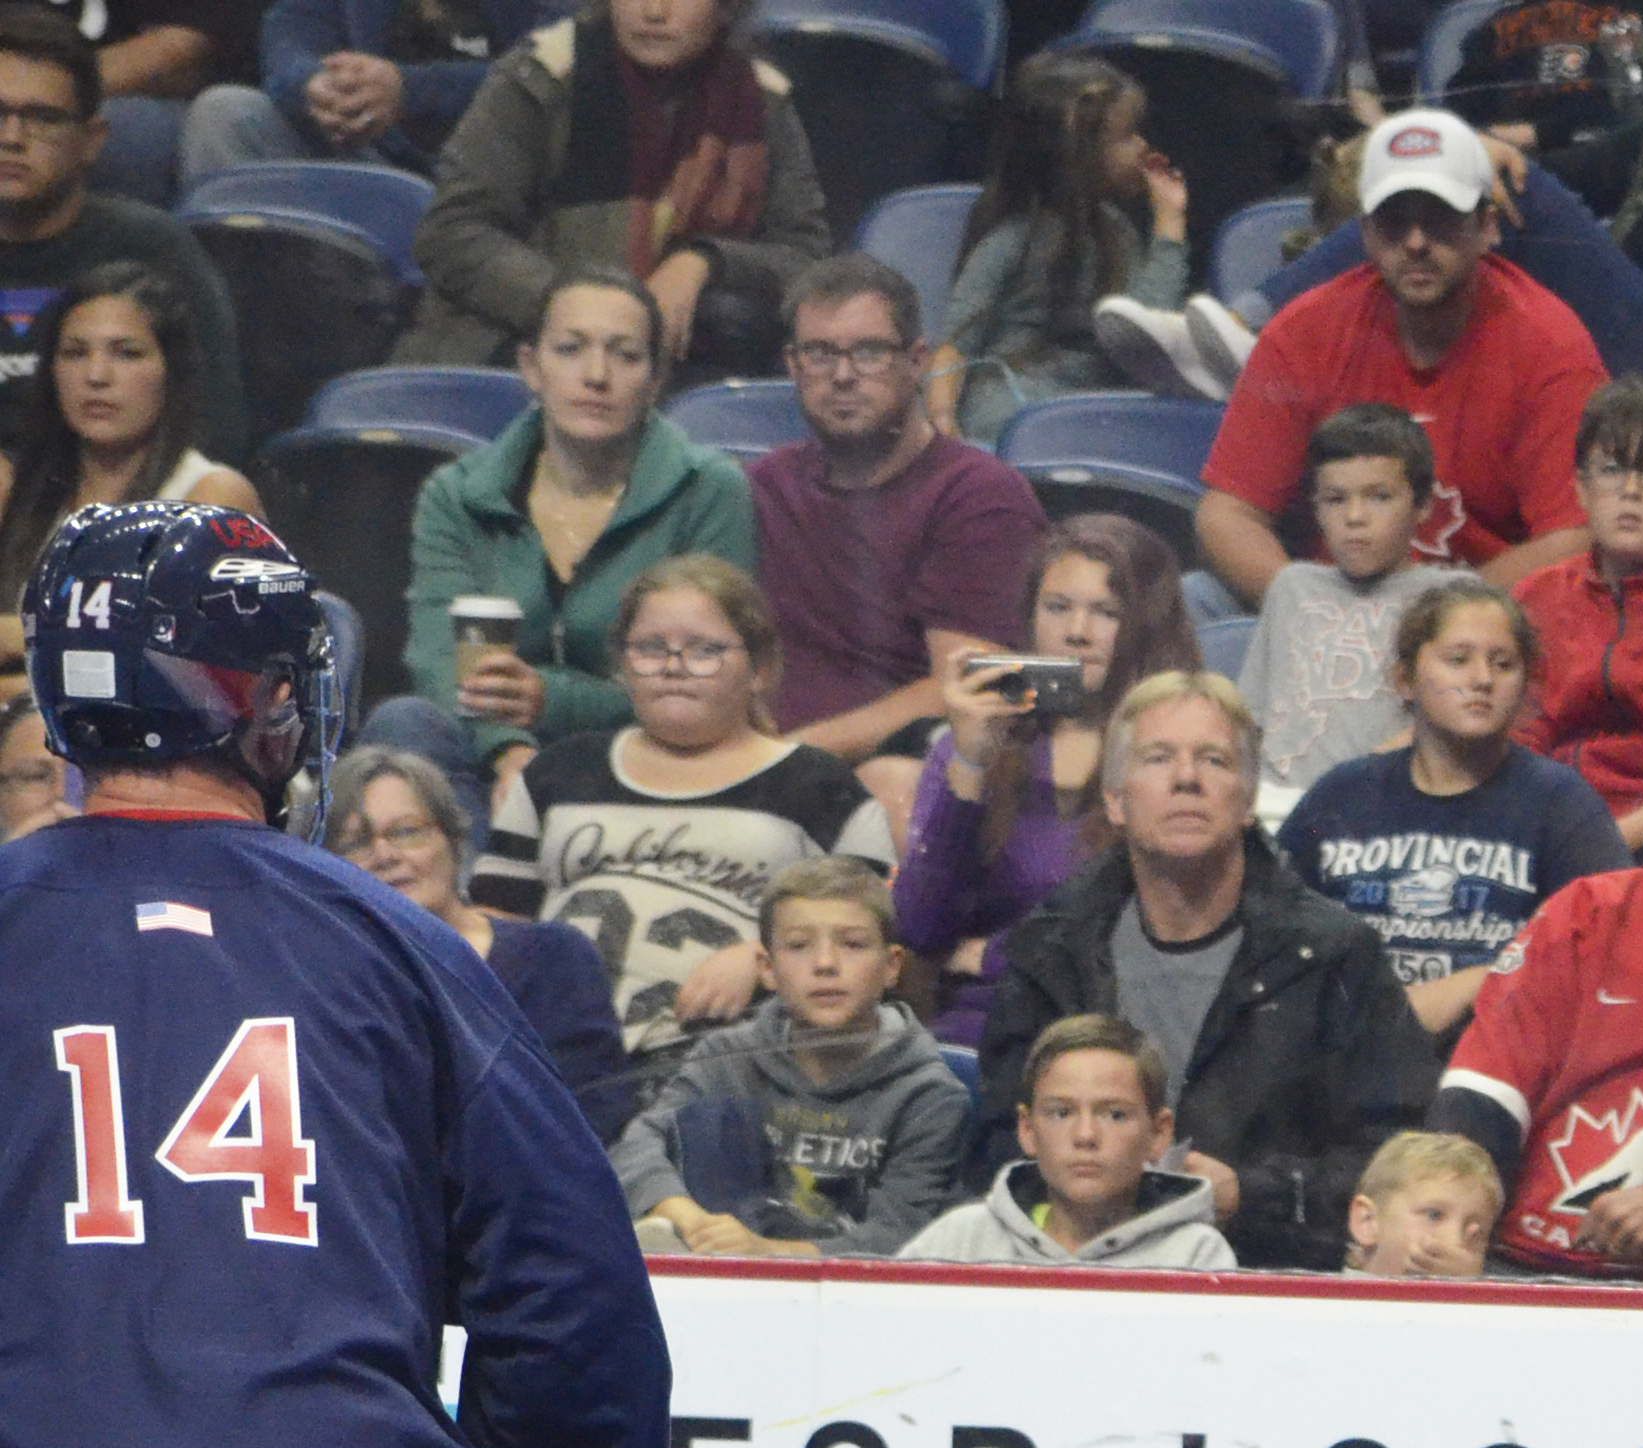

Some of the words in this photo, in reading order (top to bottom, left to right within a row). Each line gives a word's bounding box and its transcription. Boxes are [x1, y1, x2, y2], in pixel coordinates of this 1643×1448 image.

[65, 579, 114, 629] 14
[257, 579, 306, 596] BAUER
[1319, 832, 1537, 895] PROVINCIAL
[51, 1014, 320, 1249] 14
